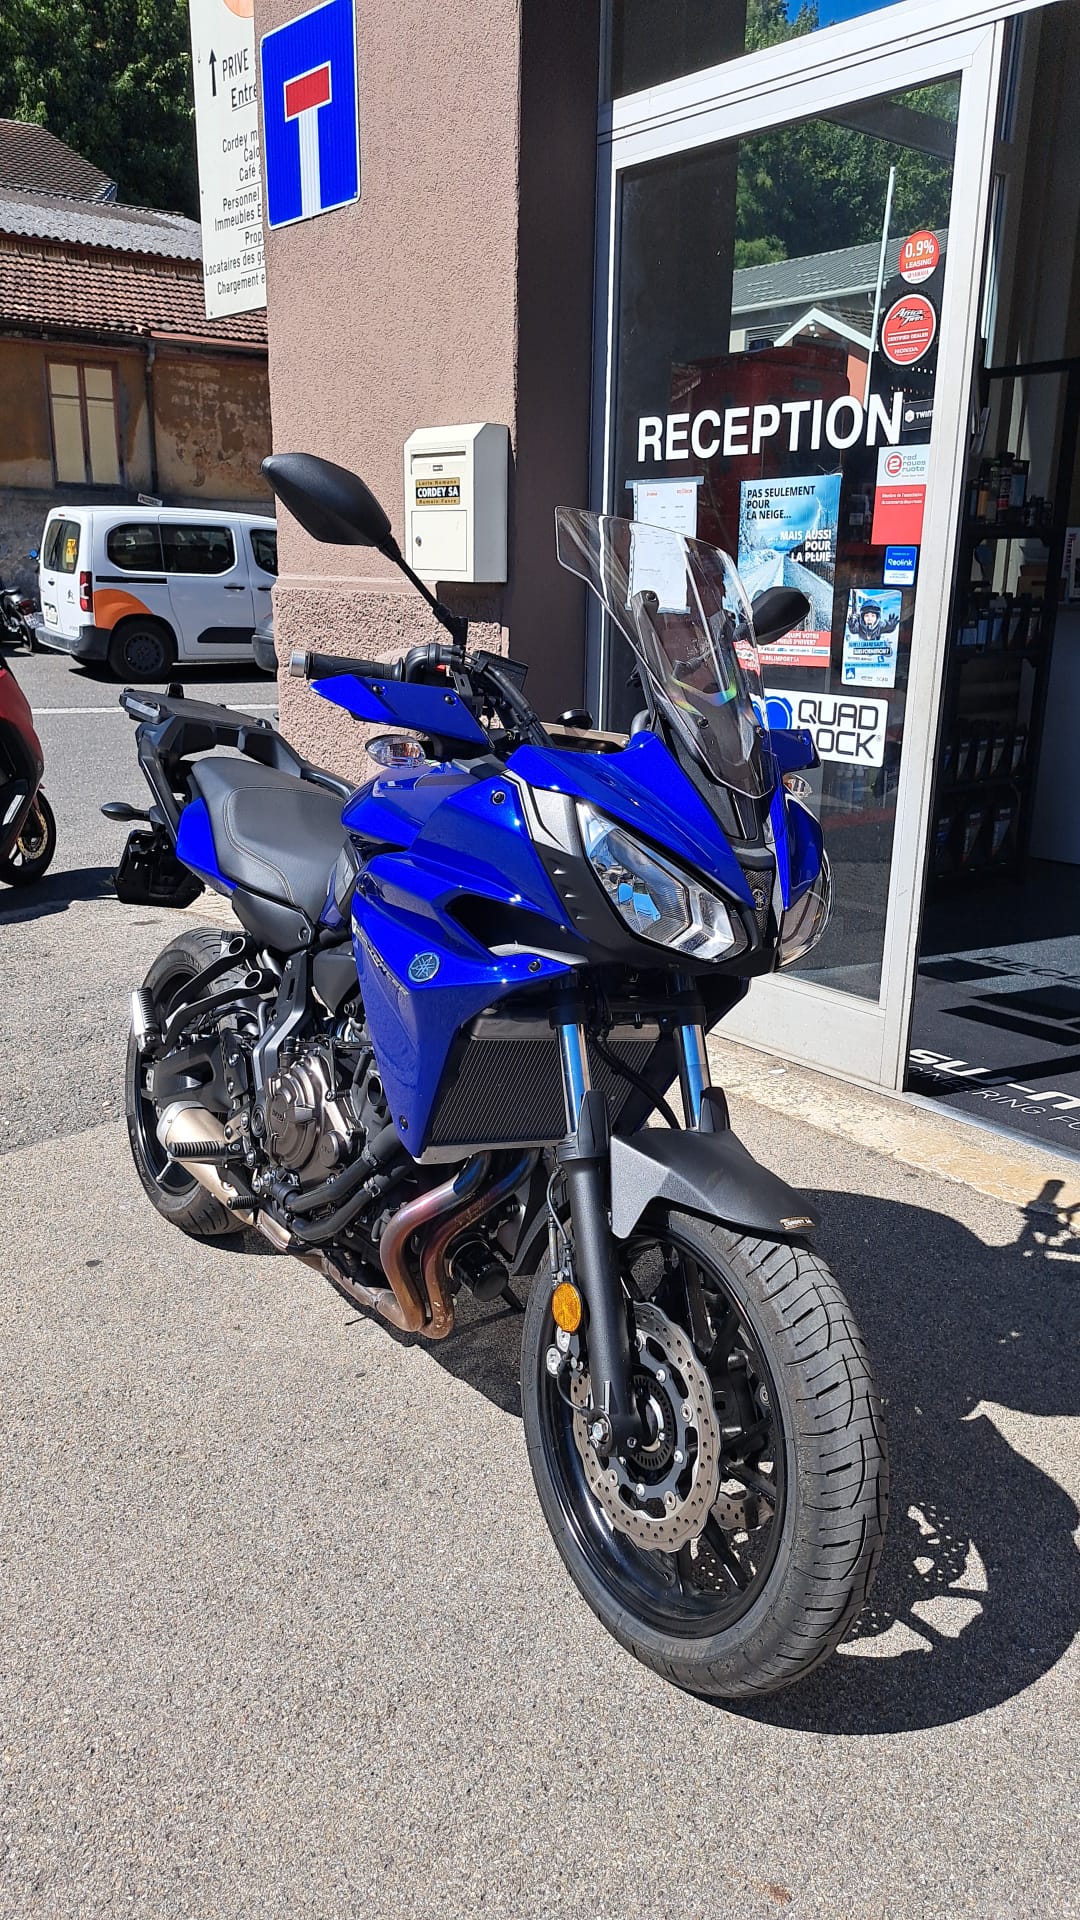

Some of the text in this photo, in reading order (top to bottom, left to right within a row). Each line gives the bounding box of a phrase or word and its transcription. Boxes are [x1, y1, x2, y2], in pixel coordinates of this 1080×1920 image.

[222, 48, 249, 81] PRIVE
[222, 133, 248, 153] Cordey
[239, 162, 256, 181] Café
[223, 186, 260, 212] Personnel
[215, 208, 255, 231] Immeubles
[905, 239, 934, 258] 0.9%
[205, 257, 241, 277] Locataires
[243, 251, 255, 266] des
[217, 272, 259, 295] Chargement
[894, 346, 918, 354] HONDA
[637, 391, 903, 463] RECEPTION
[417, 486, 458, 497] CORDEY SA
[747, 485, 816, 498] PAS SEULEMENT
[747, 500, 770, 509] POUR
[746, 510, 791, 520] LA NEIGE...
[780, 529, 832, 540] MAIS AUSSI
[805, 541, 831, 551] POUR
[791, 552, 831, 562] LA PLUIE
[798, 699, 879, 731] QUAD
[798, 726, 876, 759] OCK
